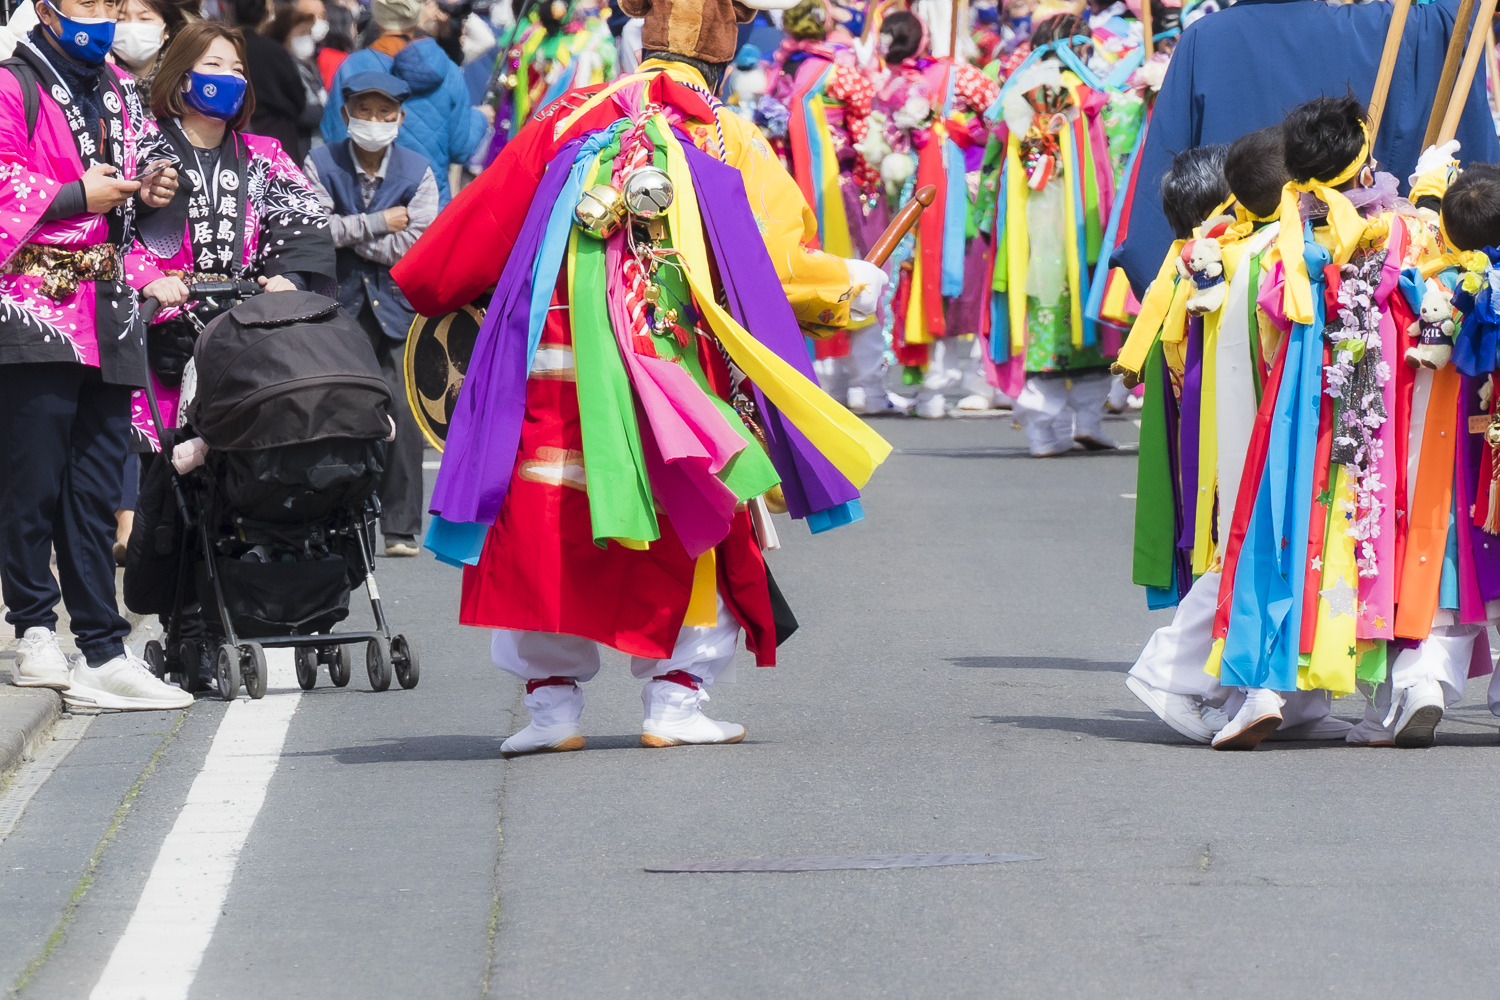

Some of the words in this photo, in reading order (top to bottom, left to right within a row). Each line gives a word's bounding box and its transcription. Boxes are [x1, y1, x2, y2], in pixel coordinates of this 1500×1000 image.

[193, 221, 217, 269] 居合
[217, 194, 238, 268] 鹿島神
